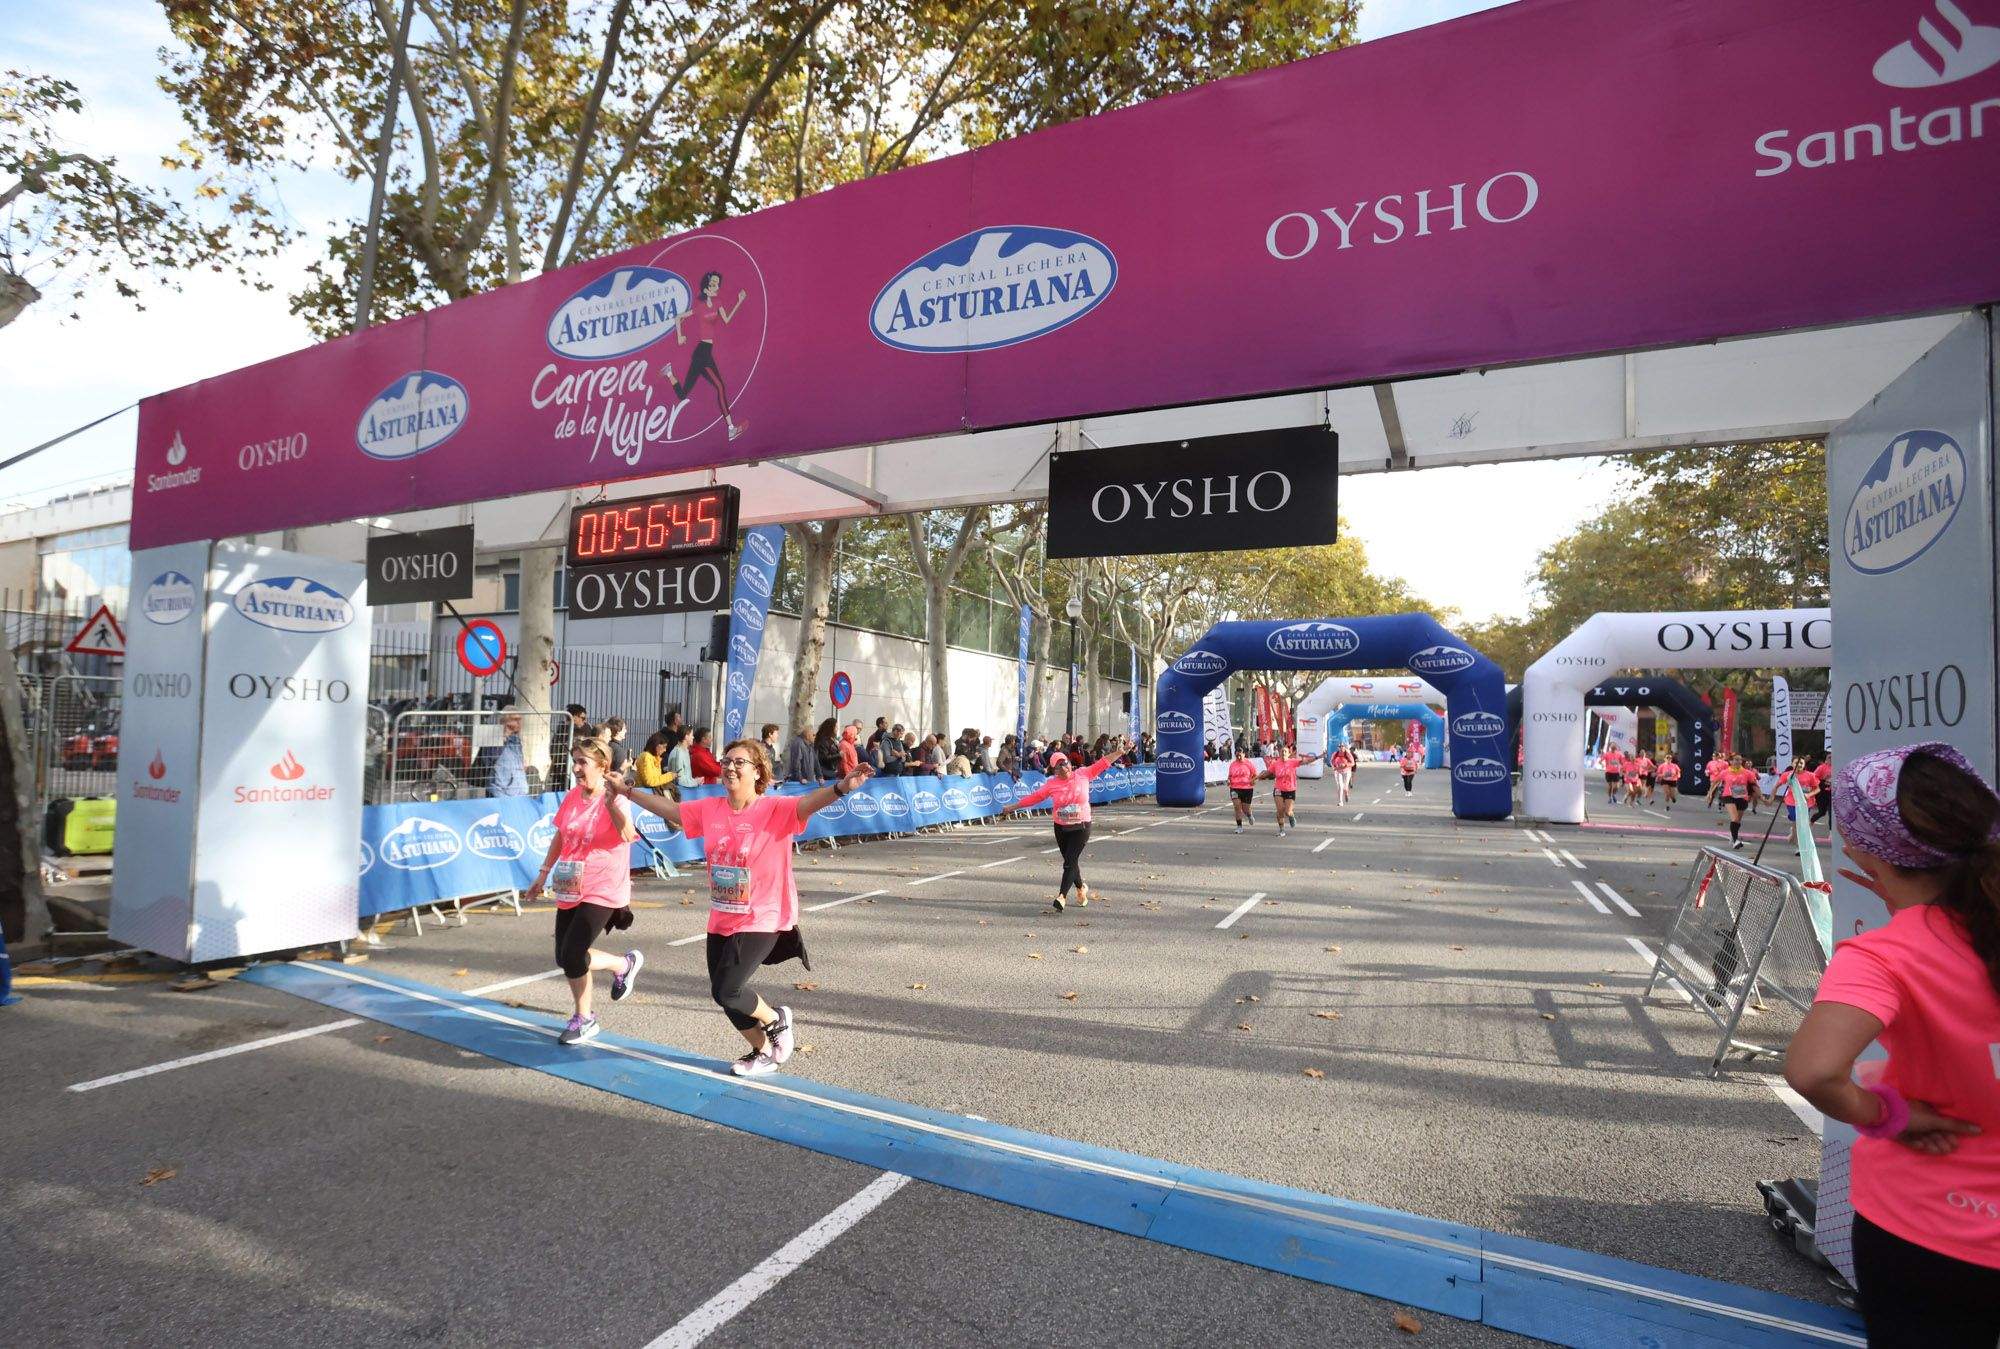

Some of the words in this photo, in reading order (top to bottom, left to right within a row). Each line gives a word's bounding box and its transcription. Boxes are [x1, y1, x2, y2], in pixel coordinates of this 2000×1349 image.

[1265, 171, 1539, 260] OYSHO
[923, 270, 997, 293] CENTRAL
[1005, 251, 1088, 278] LECHERA
[886, 268, 1096, 334] ASTURIANA
[556, 297, 679, 345] ASTURIANA
[531, 360, 649, 409] Carrera
[364, 403, 458, 444] ASTURIANA
[554, 408, 576, 439] de
[580, 404, 597, 436] la
[590, 387, 690, 465] Mujer
[239, 432, 308, 471] OYSHO
[1092, 470, 1291, 523] OYSHO
[1850, 473, 1956, 556] ASTURIANA
[577, 496, 717, 556] 00:56:45
[381, 551, 458, 583] OYSHO
[576, 563, 721, 612] OYSHO
[242, 592, 346, 623] ASTURIANA
[1274, 634, 1353, 650] ASTURIANA
[1657, 619, 1831, 651] OYSHO
[1415, 657, 1470, 668] ASTURIANA
[1556, 656, 1606, 667] OYSHO
[133, 672, 193, 699] OYSHO
[229, 673, 351, 704] OYSHO
[1845, 664, 1967, 734] OYSHO
[1159, 721, 1192, 729] STURIANA
[1532, 712, 1578, 722] OYSHO
[1694, 721, 1702, 786] VOLVO
[133, 781, 181, 803] Santander
[234, 785, 335, 804] Santander
[1532, 770, 1578, 780] OYSHO
